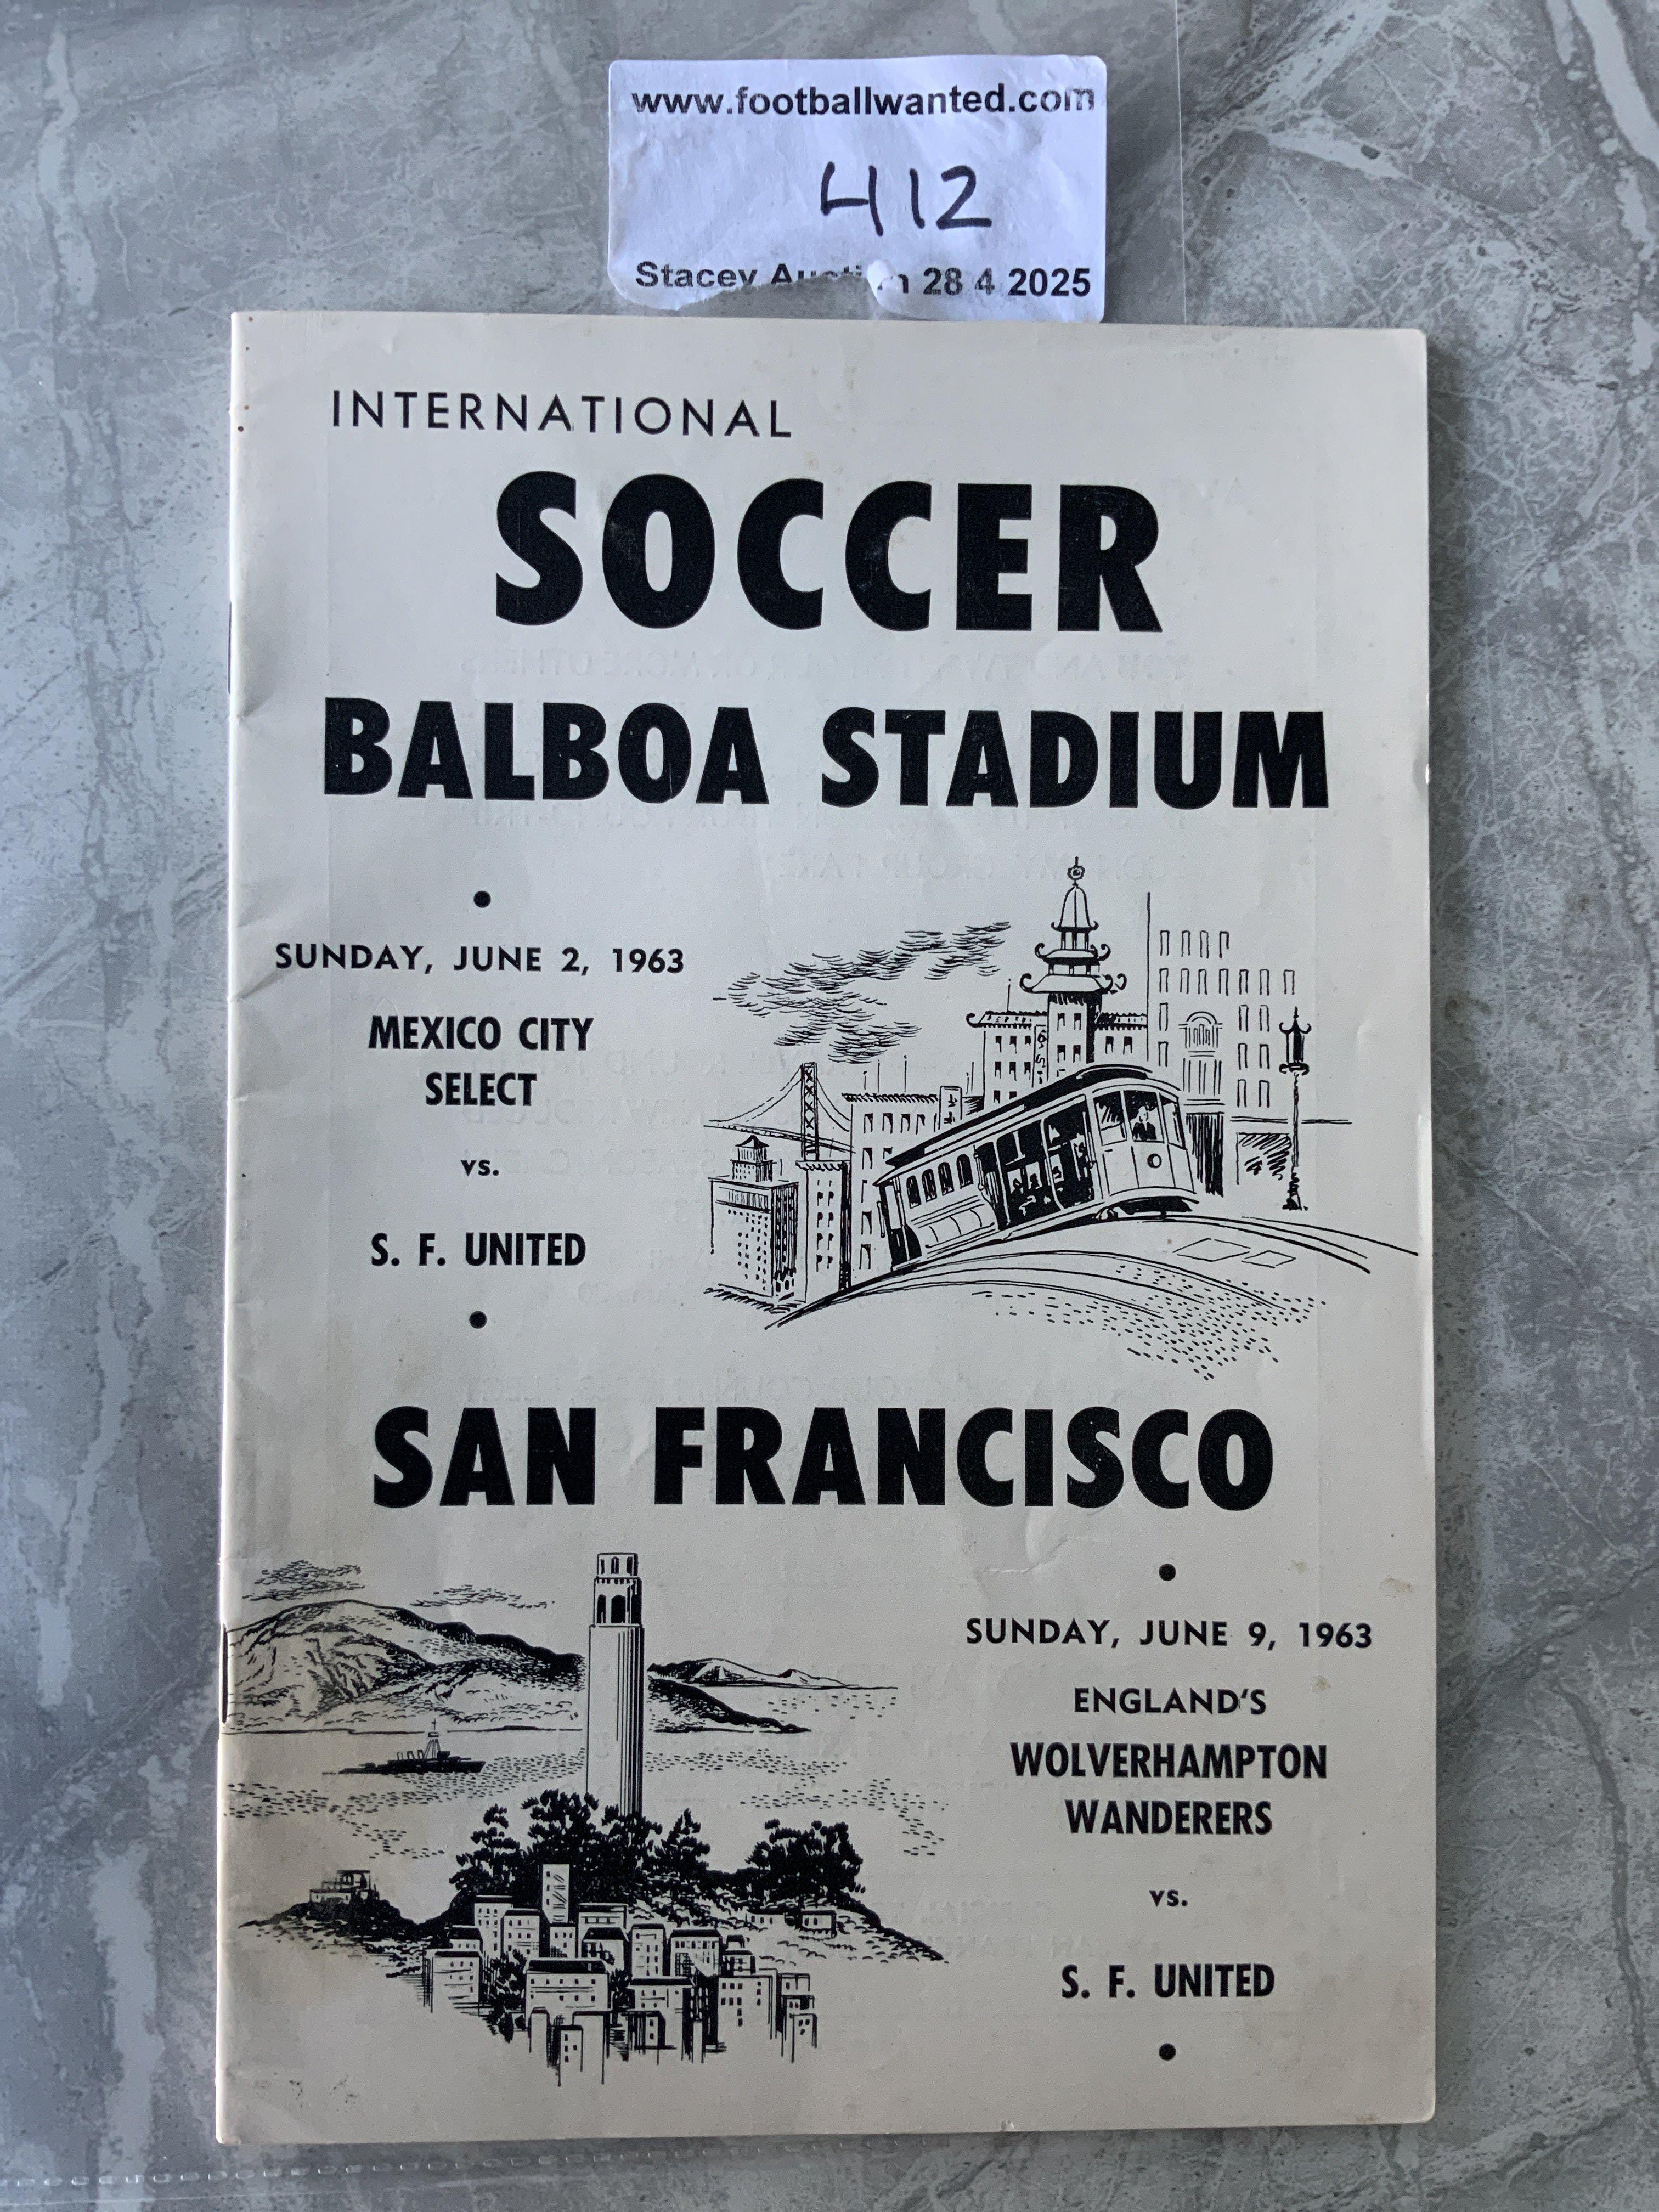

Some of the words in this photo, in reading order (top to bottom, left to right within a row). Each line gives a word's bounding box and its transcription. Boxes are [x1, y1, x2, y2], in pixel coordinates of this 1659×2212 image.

[631, 83, 1095, 116] www.footballwanted.com
[820, 161, 992, 237] 412
[923, 267, 963, 296] 28
[974, 268, 995, 296] 4
[1008, 268, 1091, 297] 2025
[332, 390, 792, 438] INTERNATIONAL
[495, 471, 1163, 633] SOCCER
[324, 697, 770, 805] BALBOA
[822, 706, 1329, 810] STADIUM
[275, 943, 433, 974] SUNDAY,
[453, 946, 542, 972] JUNE
[561, 947, 589, 976] 2,
[612, 948, 684, 974] 1963
[368, 1015, 501, 1051] MEXICO
[518, 1017, 595, 1051] CITY
[425, 1071, 538, 1107] SELECT
[460, 1159, 499, 1177] vs.
[371, 1232, 400, 1267] S.
[419, 1233, 447, 1267] F.
[465, 1232, 586, 1267] UNITED
[373, 1406, 596, 1509] SAN
[653, 1406, 1273, 1511] FRANCISCO
[966, 1617, 1120, 1649] SUNDAY,
[1139, 1619, 1228, 1647] JUNE
[1248, 1621, 1276, 1651] 9,
[1299, 1622, 1372, 1649] 1963
[1074, 1686, 1267, 1716] ENGLAND'S
[1009, 1742, 1327, 1779] WOLVERHAMPTON
[1064, 1799, 1273, 1836] WANDERERS
[1149, 1889, 1188, 1907] vs.
[1062, 1964, 1090, 1999] S.
[1108, 1964, 1136, 1999] F.
[1154, 1963, 1275, 1999] UNITED
